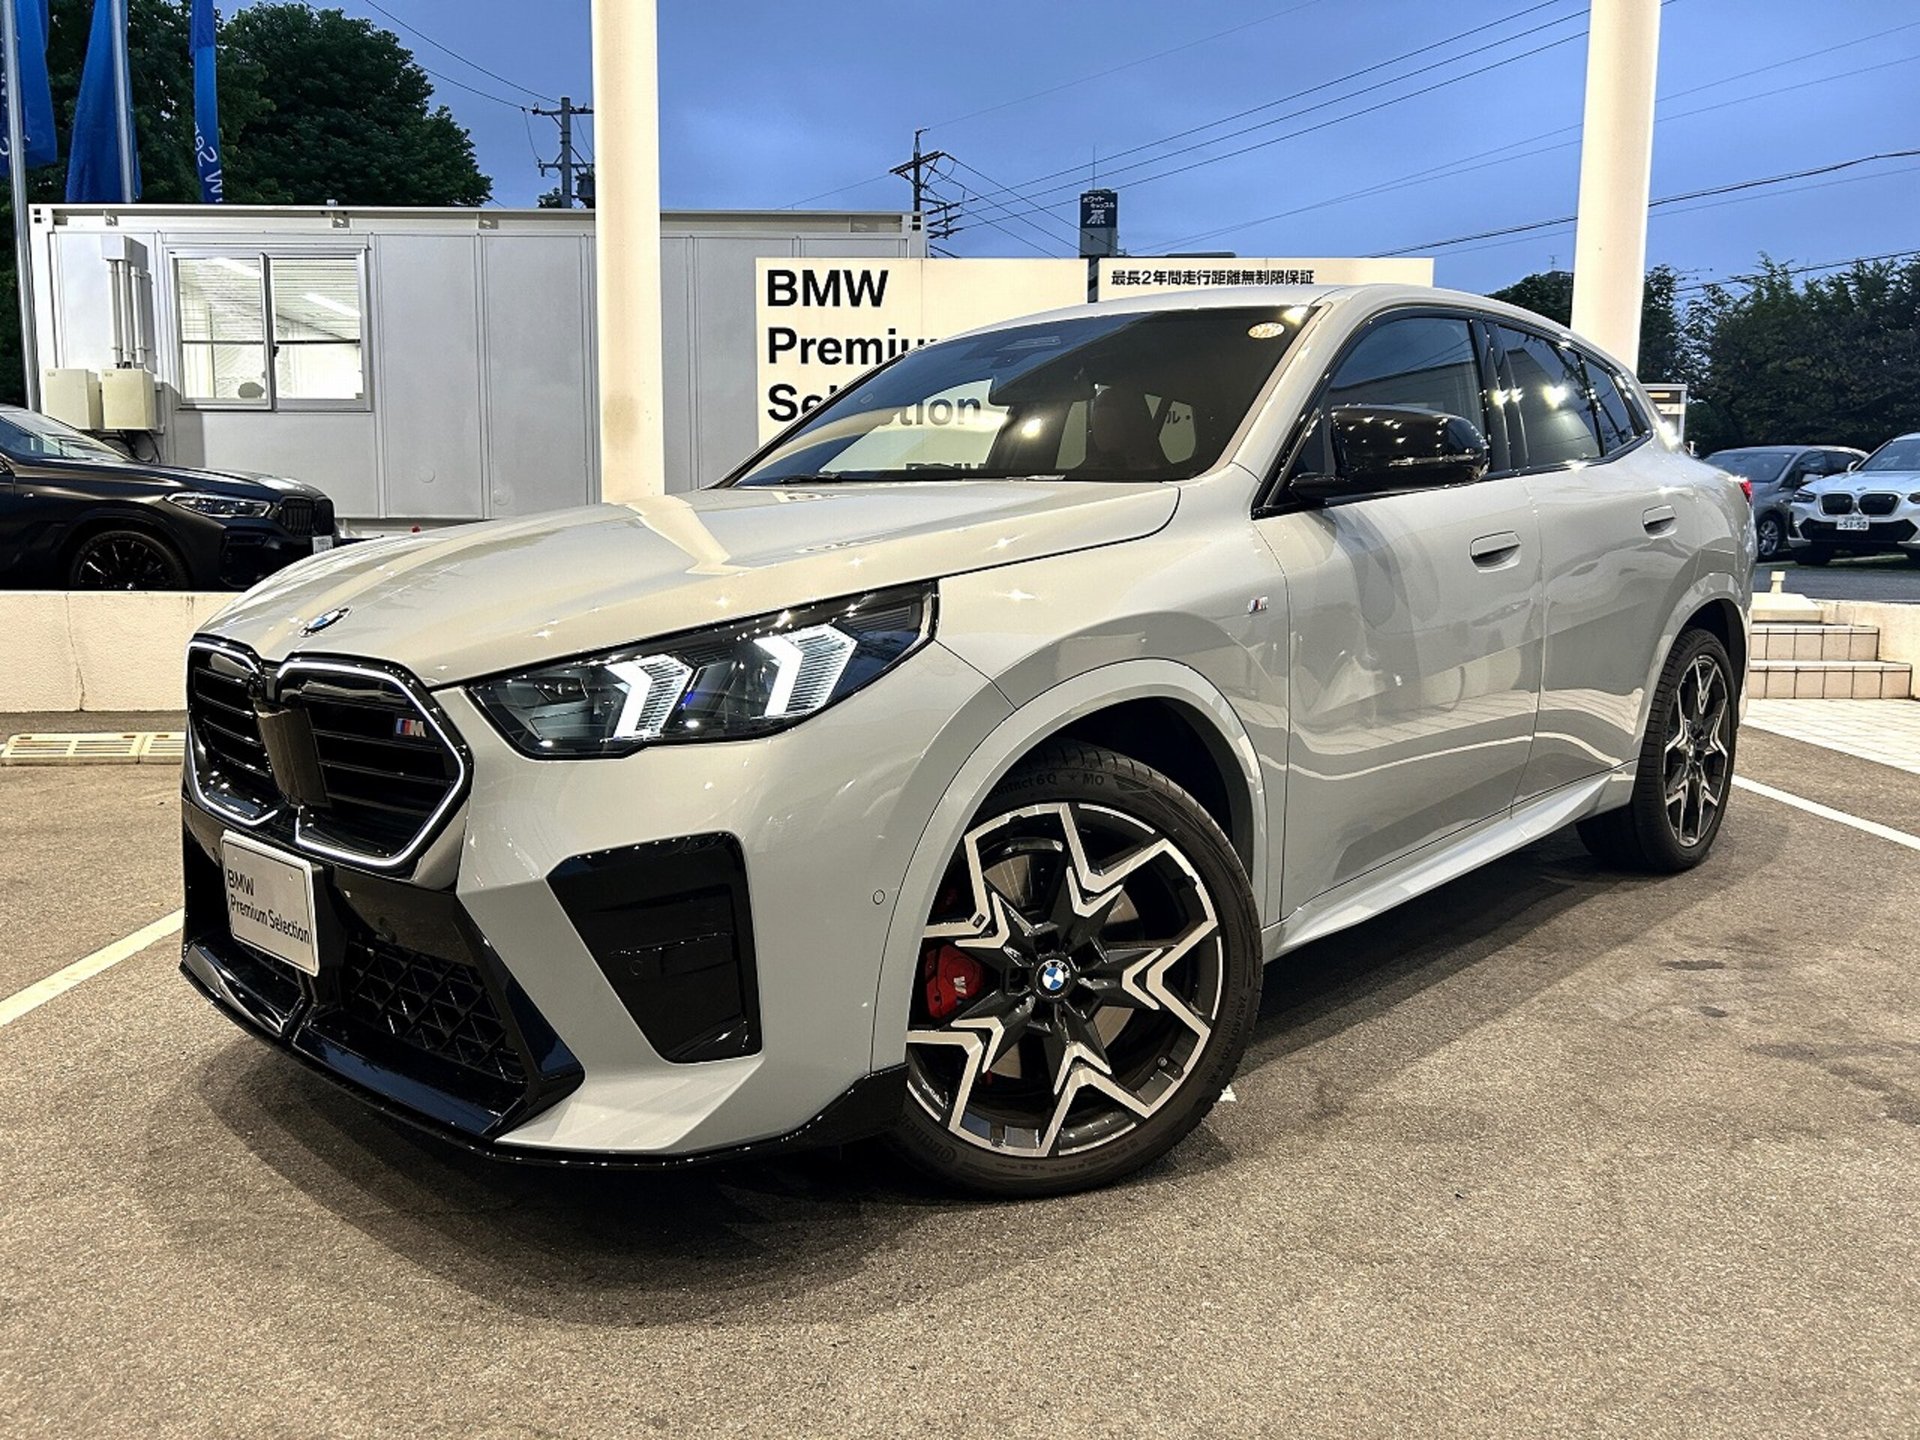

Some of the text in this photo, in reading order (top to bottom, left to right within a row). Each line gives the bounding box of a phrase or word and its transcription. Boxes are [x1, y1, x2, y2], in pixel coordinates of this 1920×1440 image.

[767, 269, 889, 307] BMW
[1111, 269, 1315, 286] 最長2年間走行距離無制限保証
[767, 327, 938, 365] Premi
[228, 869, 254, 896] BMW
[231, 895, 310, 944] Premium Selection
